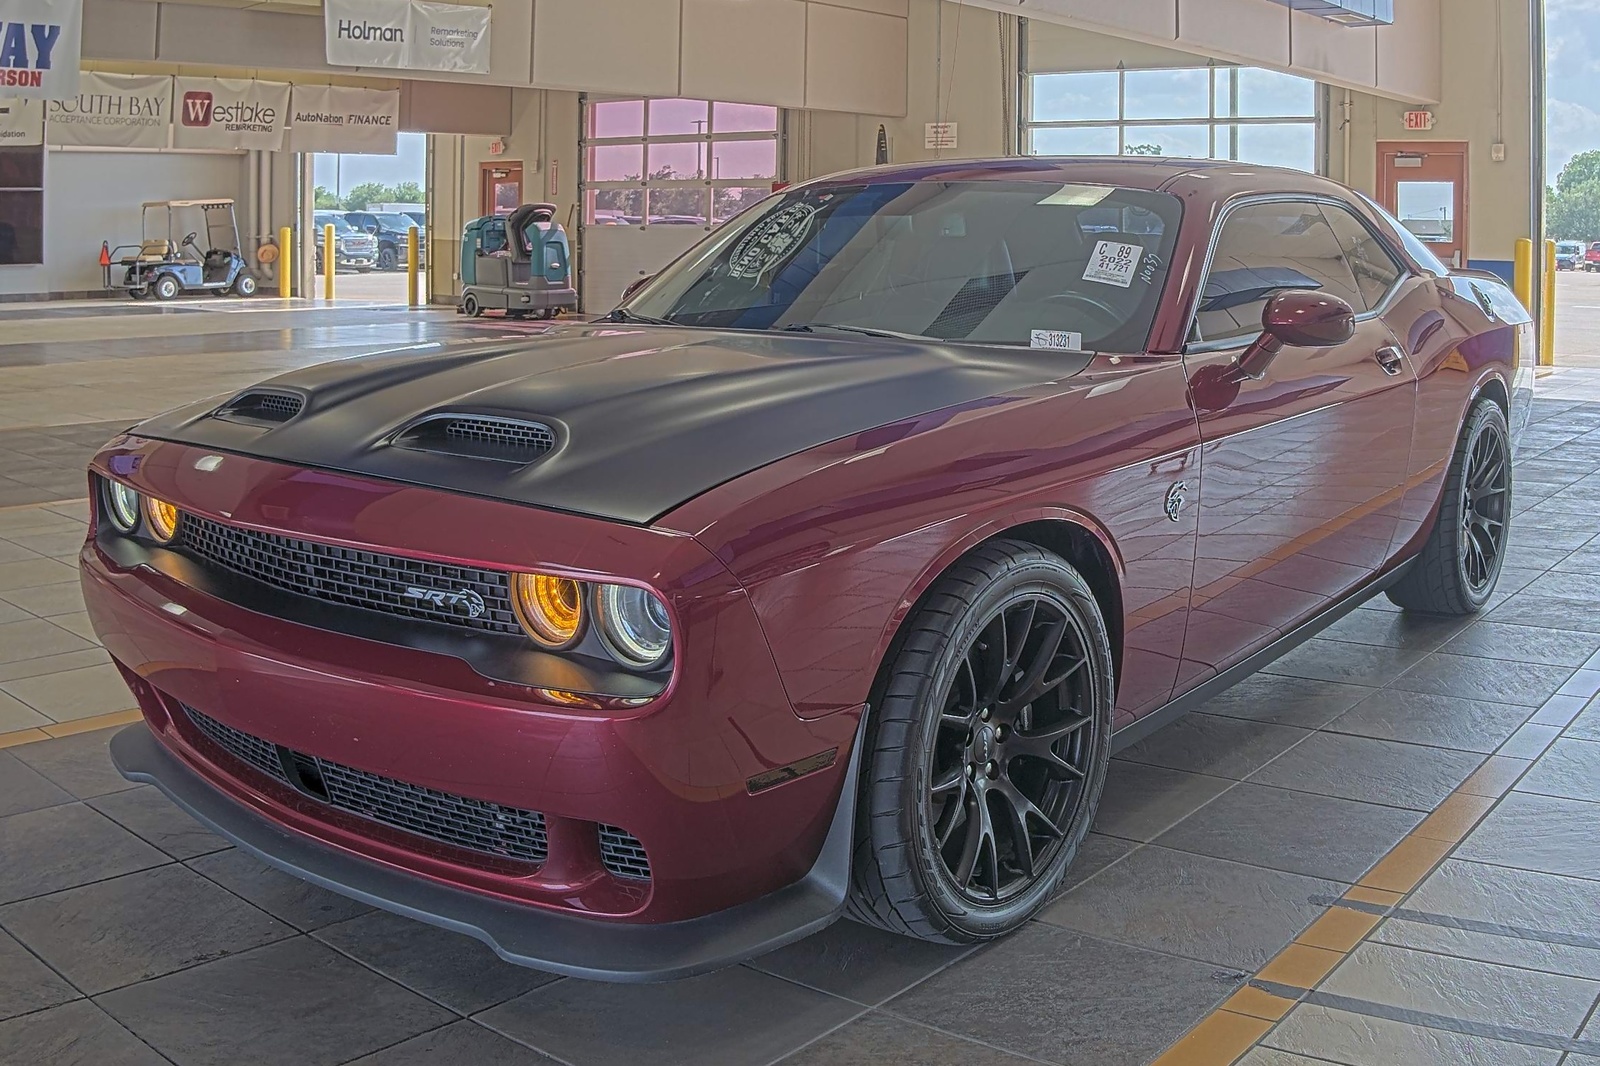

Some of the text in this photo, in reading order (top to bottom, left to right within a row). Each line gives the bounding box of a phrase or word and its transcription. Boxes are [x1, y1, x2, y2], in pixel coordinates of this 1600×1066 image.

[338, 19, 404, 43] Holman
[431, 26, 478, 40] Remarketing
[0, 22, 61, 70] AY
[430, 38, 465, 48] Solutions
[50, 94, 165, 116] SOUTH BAY
[186, 99, 275, 124] Westlake
[49, 114, 160, 127] ACCEPTANCE CORPORATION
[295, 112, 392, 126] AutoNation FINANCE
[1408, 112, 1428, 129] EXIT
[1099, 243, 1132, 259] C 89
[1099, 255, 1132, 267] 2022
[1048, 333, 1070, 348] 313231
[403, 586, 467, 606] SRT
